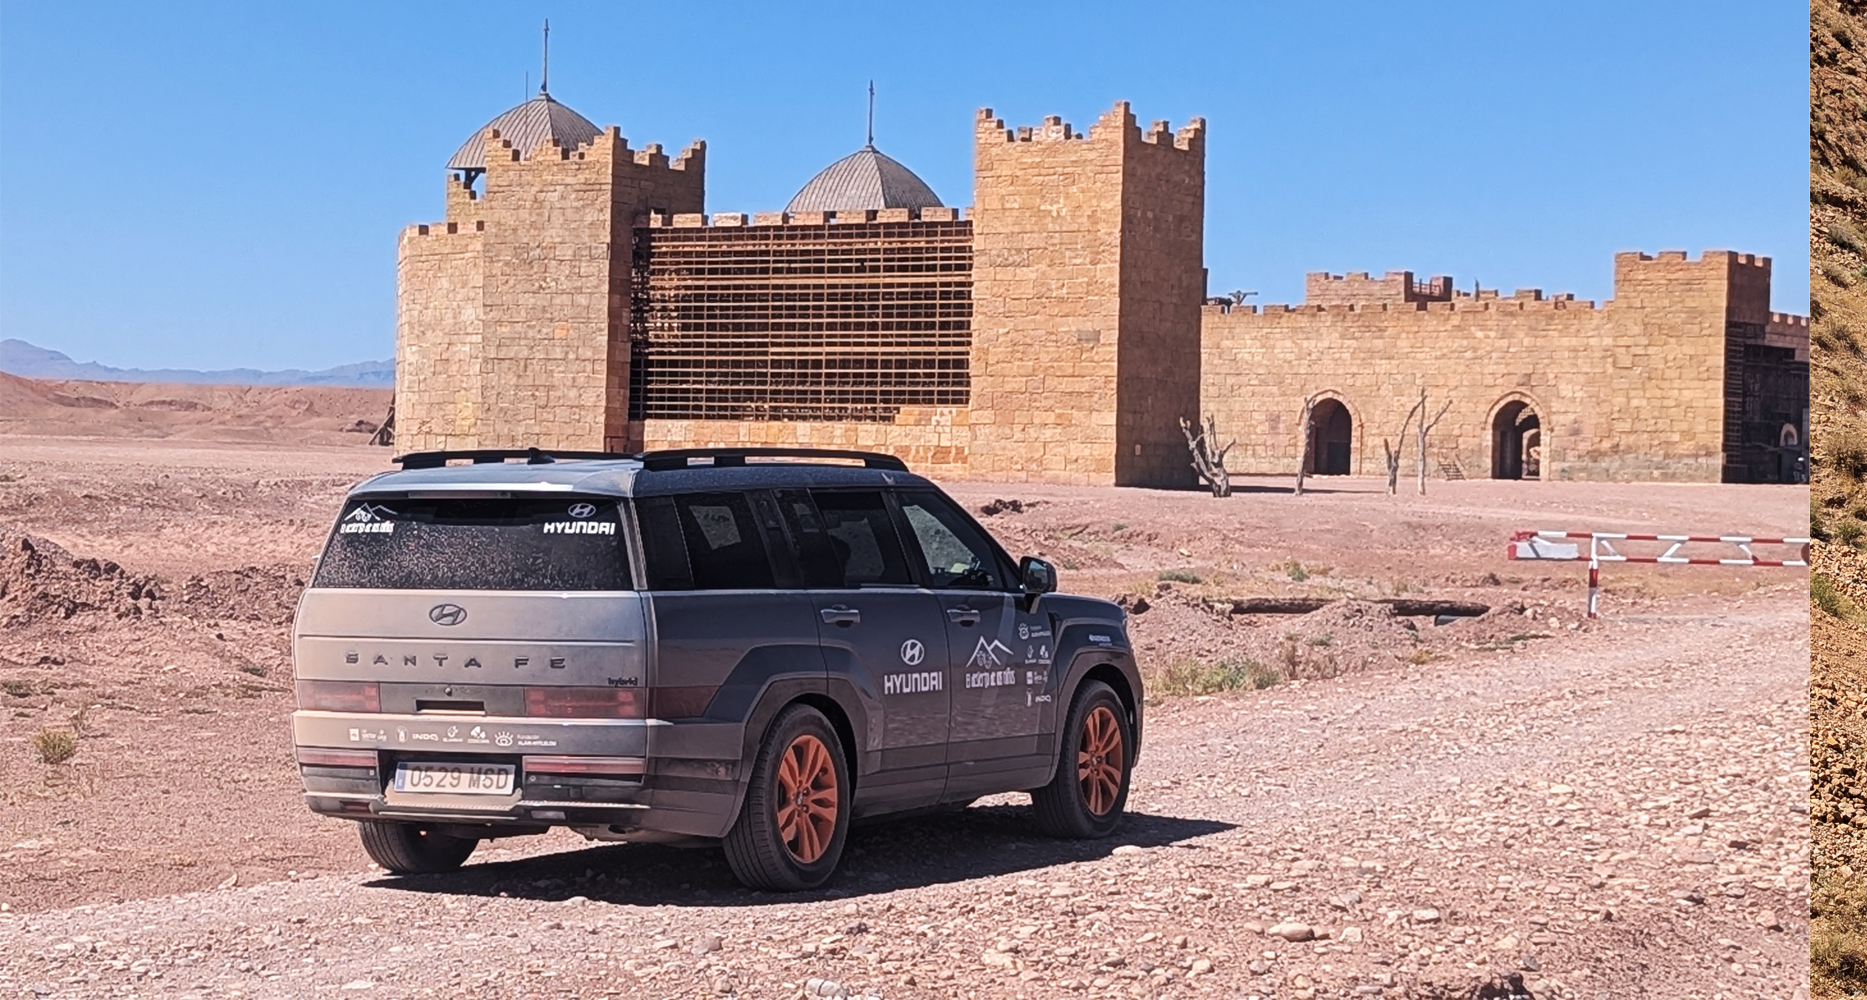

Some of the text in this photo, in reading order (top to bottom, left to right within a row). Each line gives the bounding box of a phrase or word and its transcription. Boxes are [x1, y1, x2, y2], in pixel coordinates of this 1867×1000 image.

[543, 521, 616, 535] HYUNDAI
[345, 652, 566, 669] SANTA FE
[607, 676, 638, 688] hybrid
[883, 671, 943, 695] HYUNDAI
[409, 765, 462, 788] 0529
[468, 766, 510, 790] MSD
